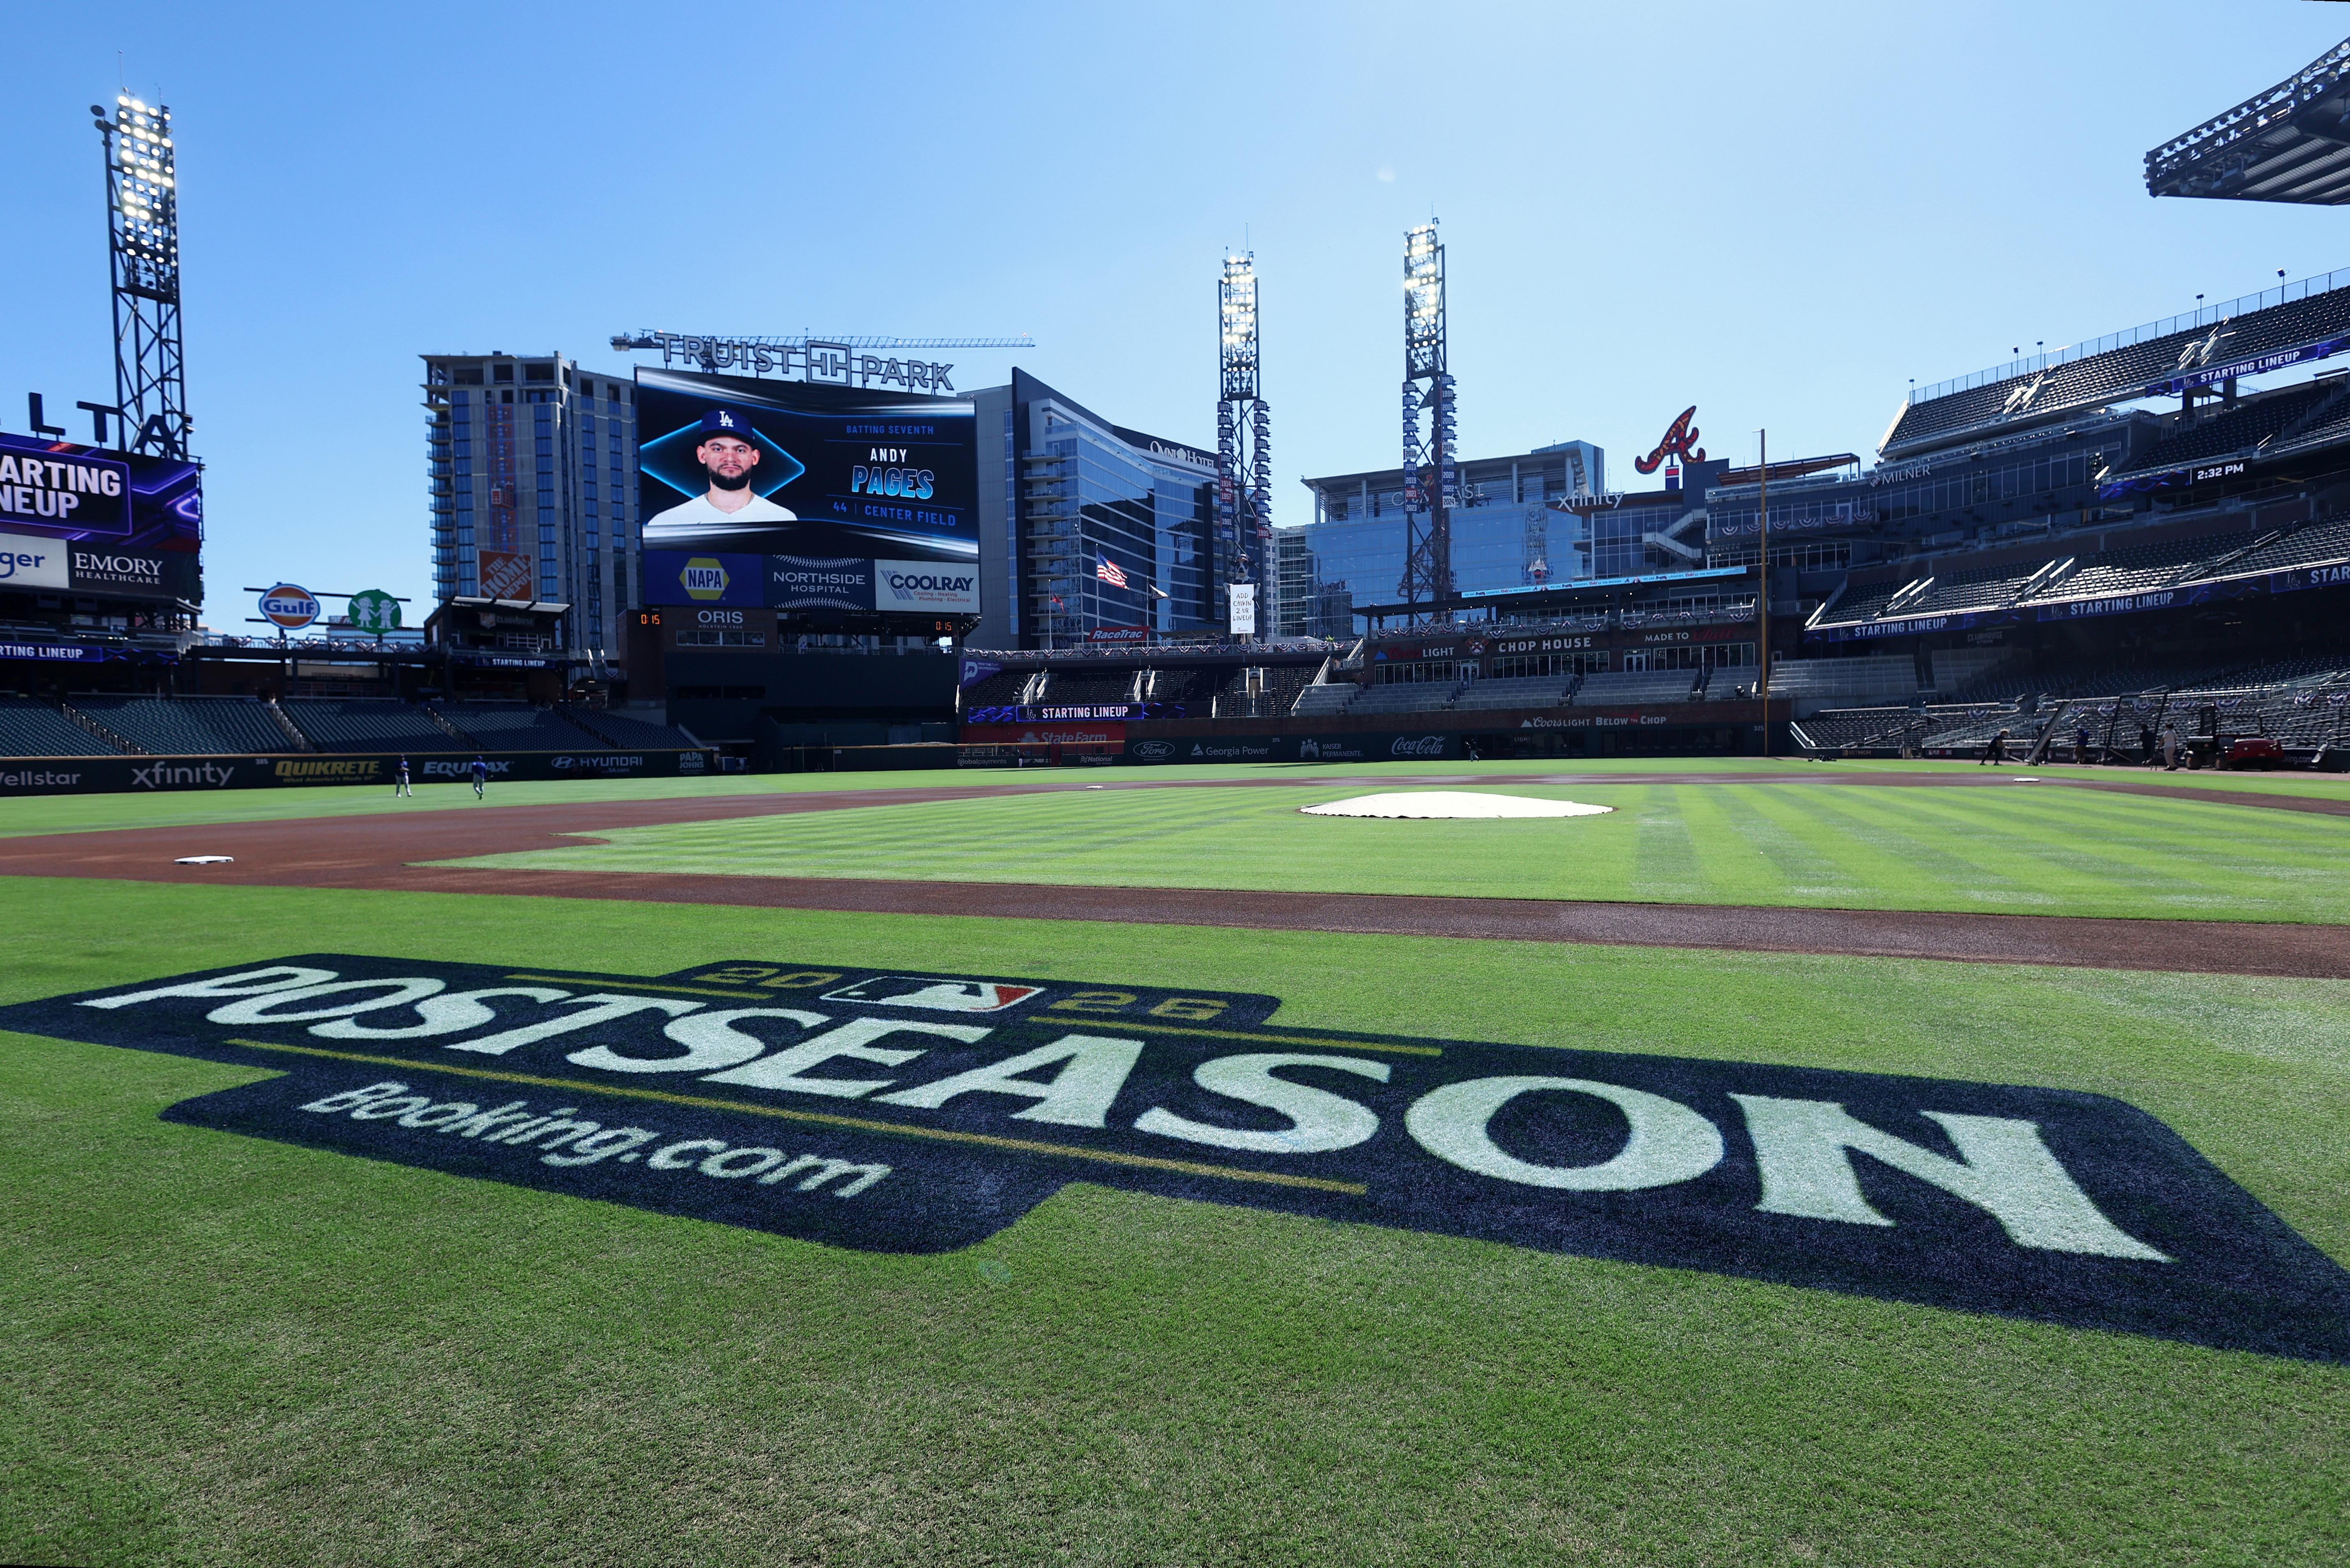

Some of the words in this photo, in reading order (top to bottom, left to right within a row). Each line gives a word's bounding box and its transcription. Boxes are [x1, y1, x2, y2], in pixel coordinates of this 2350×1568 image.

[655, 332, 796, 374] TRUIST
[862, 355, 954, 391] PARK
[2200, 361, 2254, 383] STARTING
[2258, 351, 2300, 371] LINEUP
[0, 392, 184, 461] LTA
[719, 410, 734, 427] LA
[847, 425, 884, 434] BATTING
[889, 426, 934, 435] SEVENTH
[870, 447, 907, 463] ANDY
[1150, 440, 1176, 458] OMNI
[1187, 450, 1214, 468] HOTEL
[0, 455, 121, 496] ARTING
[1882, 465, 1931, 485] MILNER
[2197, 467, 2222, 480] 2:32
[2225, 463, 2244, 475] PM
[851, 466, 935, 500] PAGES
[1558, 488, 1625, 513] xfinity
[833, 501, 847, 513] 44
[865, 505, 912, 521] CENTER
[917, 511, 956, 526] FIELD
[74, 552, 163, 576] EMORY
[76, 571, 161, 585] HEALTHCARE
[688, 570, 722, 588] NAPA
[773, 572, 866, 585] NORTHSIDE
[890, 574, 974, 591] COOLRAY
[2311, 566, 2350, 584] STAR
[791, 585, 849, 593] HOSPITAL
[263, 599, 314, 615] Gulf
[2071, 598, 2133, 615] STARTING
[2136, 592, 2174, 608] LINEUP
[641, 614, 660, 624] 0:15
[697, 611, 743, 624] ORIS
[936, 621, 951, 631] 0:15
[1855, 622, 1904, 637] STARTING
[1909, 618, 1947, 632] LINEUP
[1092, 630, 1143, 639] RaceTrac
[1645, 633, 1673, 642] MADE
[38, 647, 83, 659] LINEUP
[1423, 647, 1454, 657] LIGHT
[1498, 641, 1536, 653] CHOP
[1542, 637, 1591, 650] HOUSE
[1042, 707, 1090, 719] STARTING
[1094, 706, 1129, 717] LINEUP
[1533, 716, 1562, 728] Coors
[1563, 719, 1591, 727] LIGHT
[1596, 717, 1628, 726] BELOW
[1640, 716, 1667, 724] CHOP
[679, 752, 704, 761] PAPA
[1141, 742, 1167, 755] Ford
[1206, 747, 1240, 757] Georgia
[1242, 746, 1269, 755] Power
[275, 761, 380, 777] QUIKRETE
[423, 761, 510, 777] EQUIAX
[580, 756, 643, 767] HYUNDAI
[959, 758, 1006, 766] globalpayments
[131, 761, 235, 789] xfinity
[74, 966, 2172, 1263] POSTSEASON
[301, 1081, 893, 1199] Booking.com
